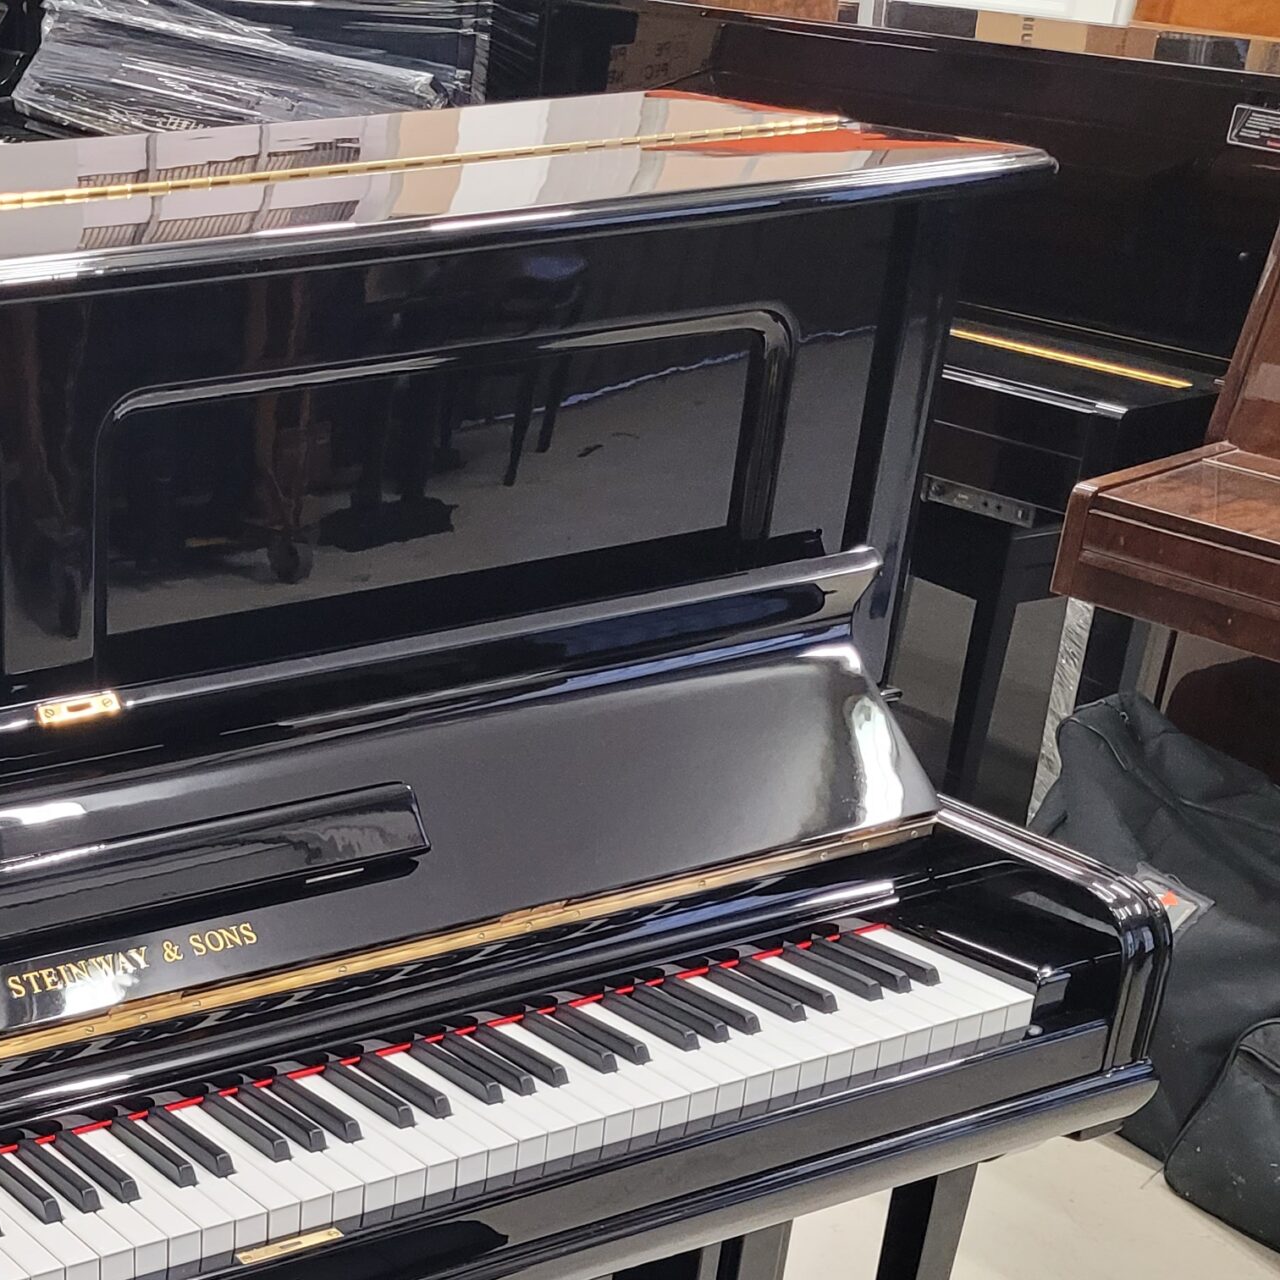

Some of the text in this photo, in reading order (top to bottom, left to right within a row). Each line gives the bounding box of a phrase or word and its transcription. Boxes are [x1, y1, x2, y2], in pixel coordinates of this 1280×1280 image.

[7, 922, 258, 999] STEINWAY & SONS
